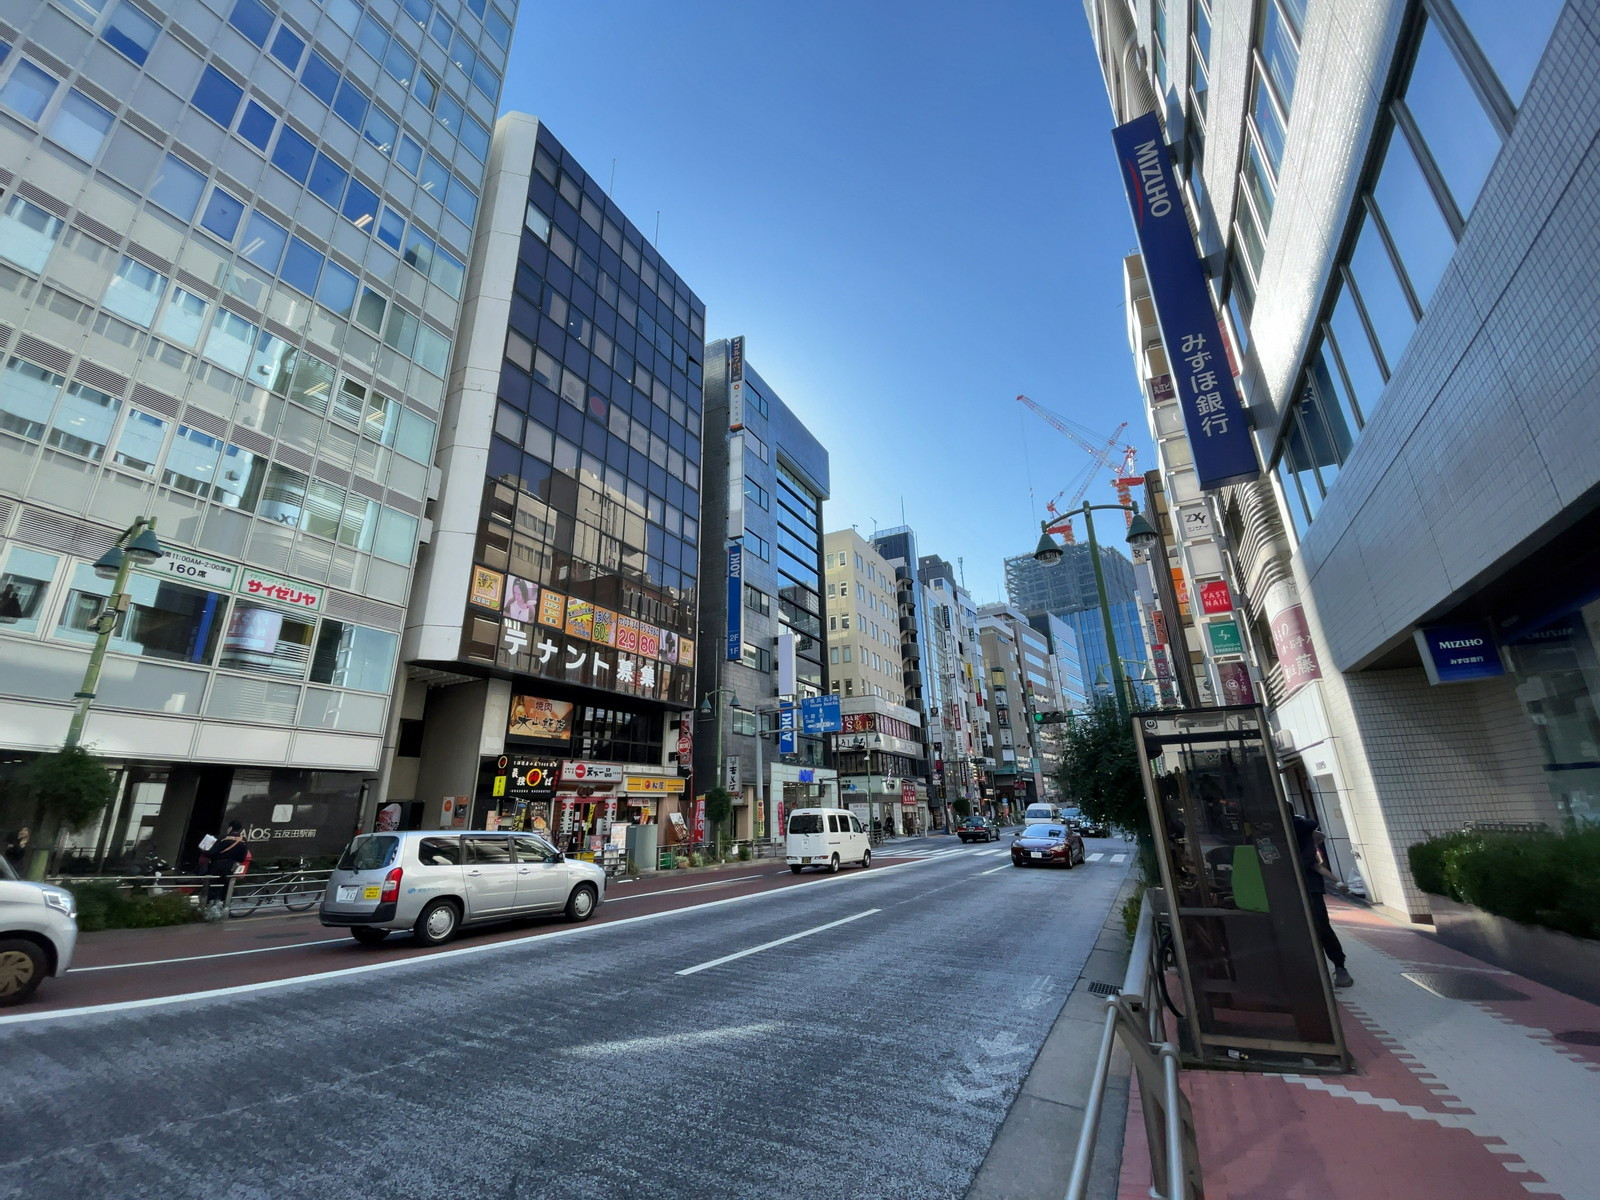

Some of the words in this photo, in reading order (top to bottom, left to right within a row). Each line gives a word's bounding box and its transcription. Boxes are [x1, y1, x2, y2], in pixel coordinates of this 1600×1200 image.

[1134, 139, 1171, 217] MIZUHO
[1181, 333, 1229, 437] みずほ銀行
[1185, 512, 1206, 524] ZXY
[168, 561, 208, 579] 160席
[730, 553, 740, 578] AOKI
[247, 579, 317, 607] サイゼリヤ
[1203, 589, 1227, 600] FAST
[1205, 599, 1229, 608] NAIL
[729, 634, 739, 642] 2F
[1439, 638, 1484, 650] MIZUHO
[729, 647, 739, 655] 1F
[1450, 656, 1485, 665] みずほ銀行
[535, 700, 553, 712] 焼肉
[781, 712, 792, 742] AOKI
[586, 766, 613, 779] 天下一品
[273, 828, 317, 839] 五反田駅前
